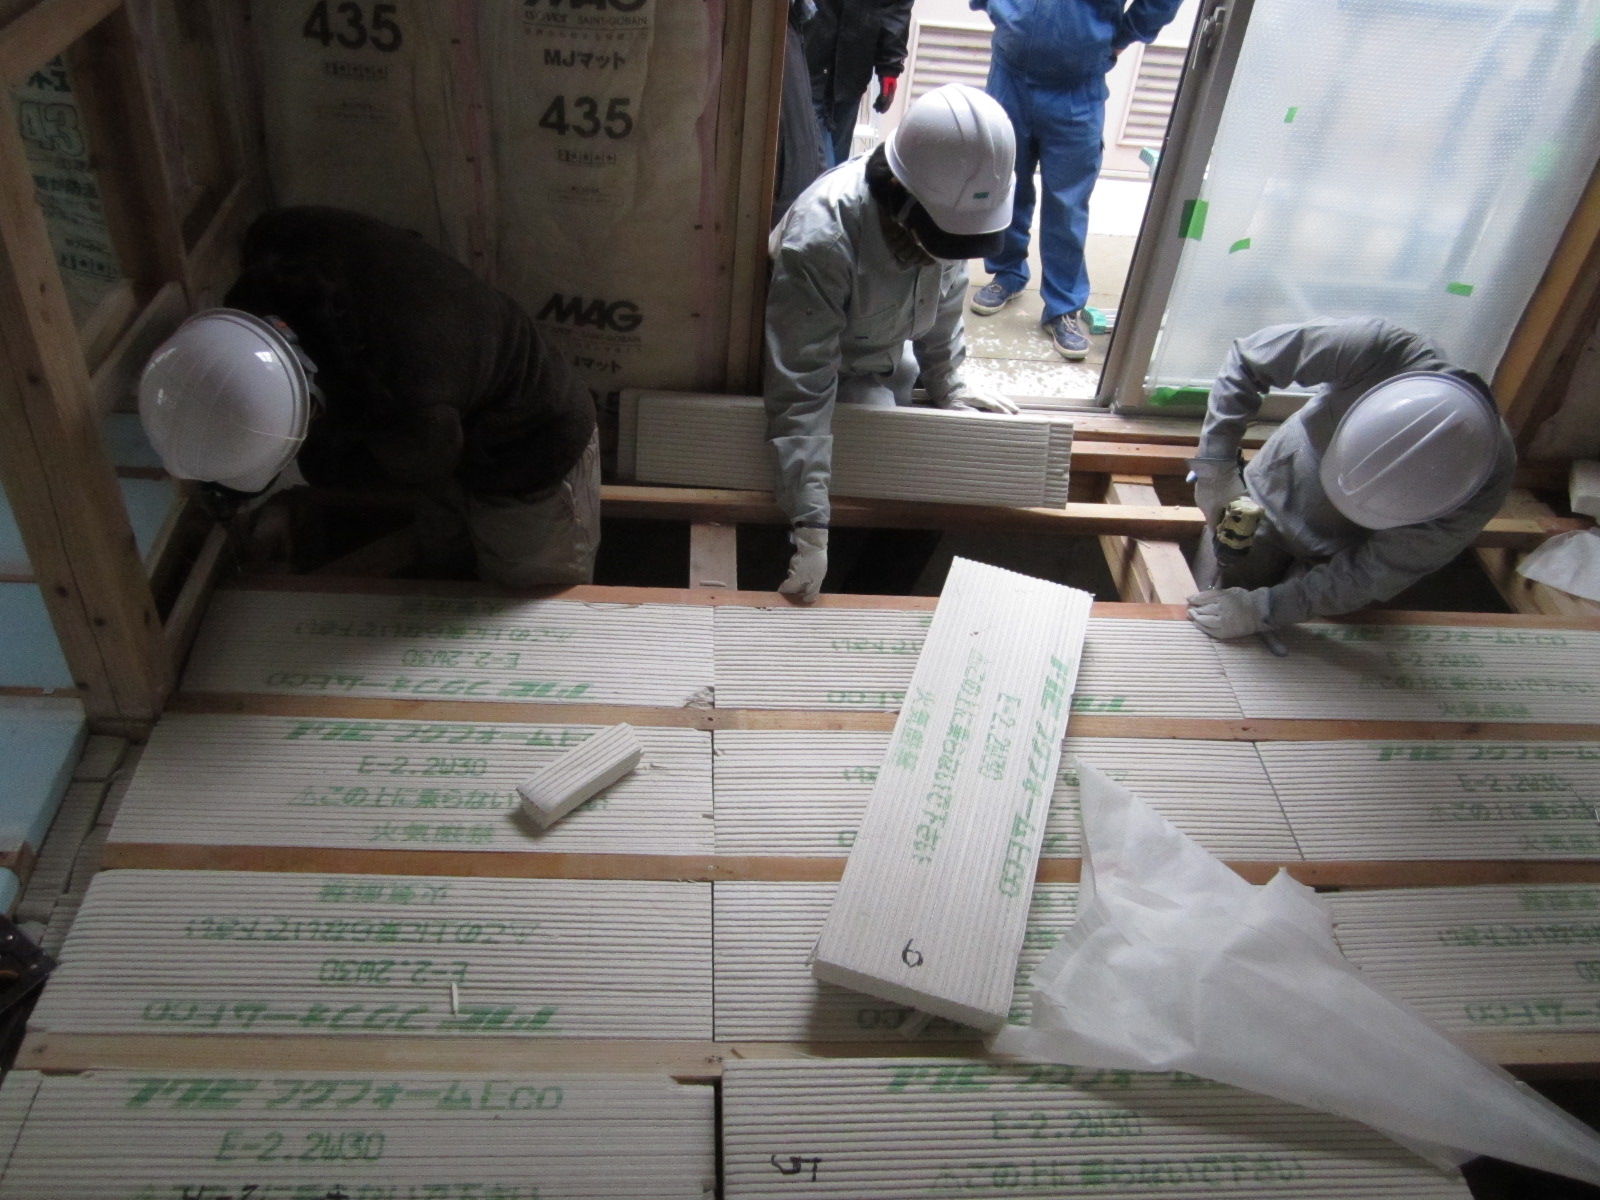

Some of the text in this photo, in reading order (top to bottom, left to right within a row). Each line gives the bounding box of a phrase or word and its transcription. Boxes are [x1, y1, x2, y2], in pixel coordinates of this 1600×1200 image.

[303, 0, 402, 53] 435
[543, 48, 626, 70] MJマット
[539, 94, 634, 140] 435
[536, 293, 644, 333] MAG
[901, 938, 924, 968] 6
[214, 1129, 387, 1162] E-2.2W30
